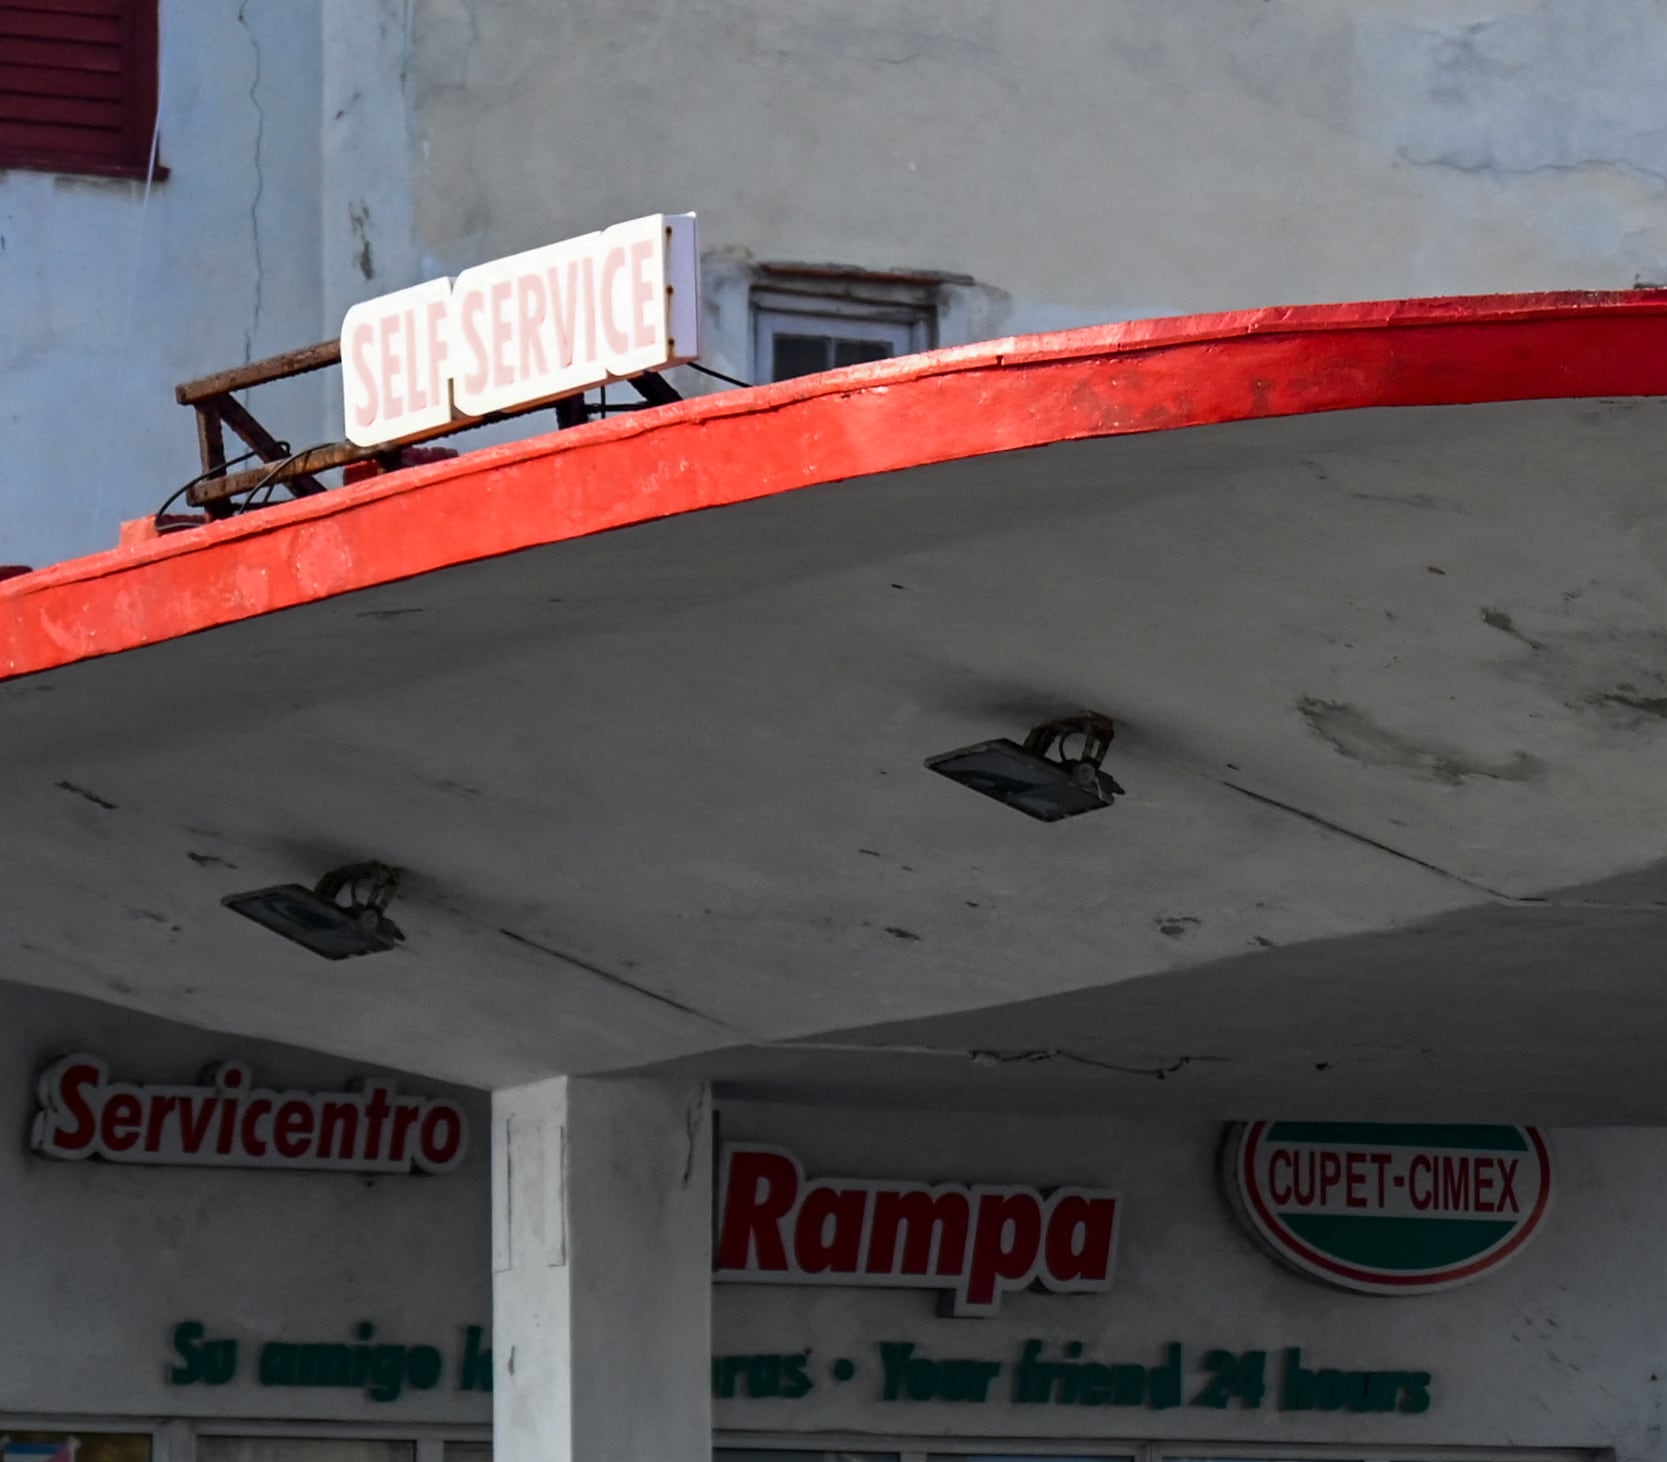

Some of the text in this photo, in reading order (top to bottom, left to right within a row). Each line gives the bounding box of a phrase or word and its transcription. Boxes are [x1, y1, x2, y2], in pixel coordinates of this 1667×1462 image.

[352, 238, 656, 428] SELF SERVICE
[53, 1064, 460, 1164] Servicentro
[718, 1151, 1115, 1304] Rampa
[1268, 1148, 1520, 1214] CUPET-CIMEX
[169, 1320, 238, 1385] Su
[258, 1320, 443, 1403] amigo
[876, 1341, 1002, 1403] Your
[1015, 1338, 1183, 1410] friend
[1202, 1348, 1267, 1410] 24
[1280, 1346, 1432, 1413] hours
